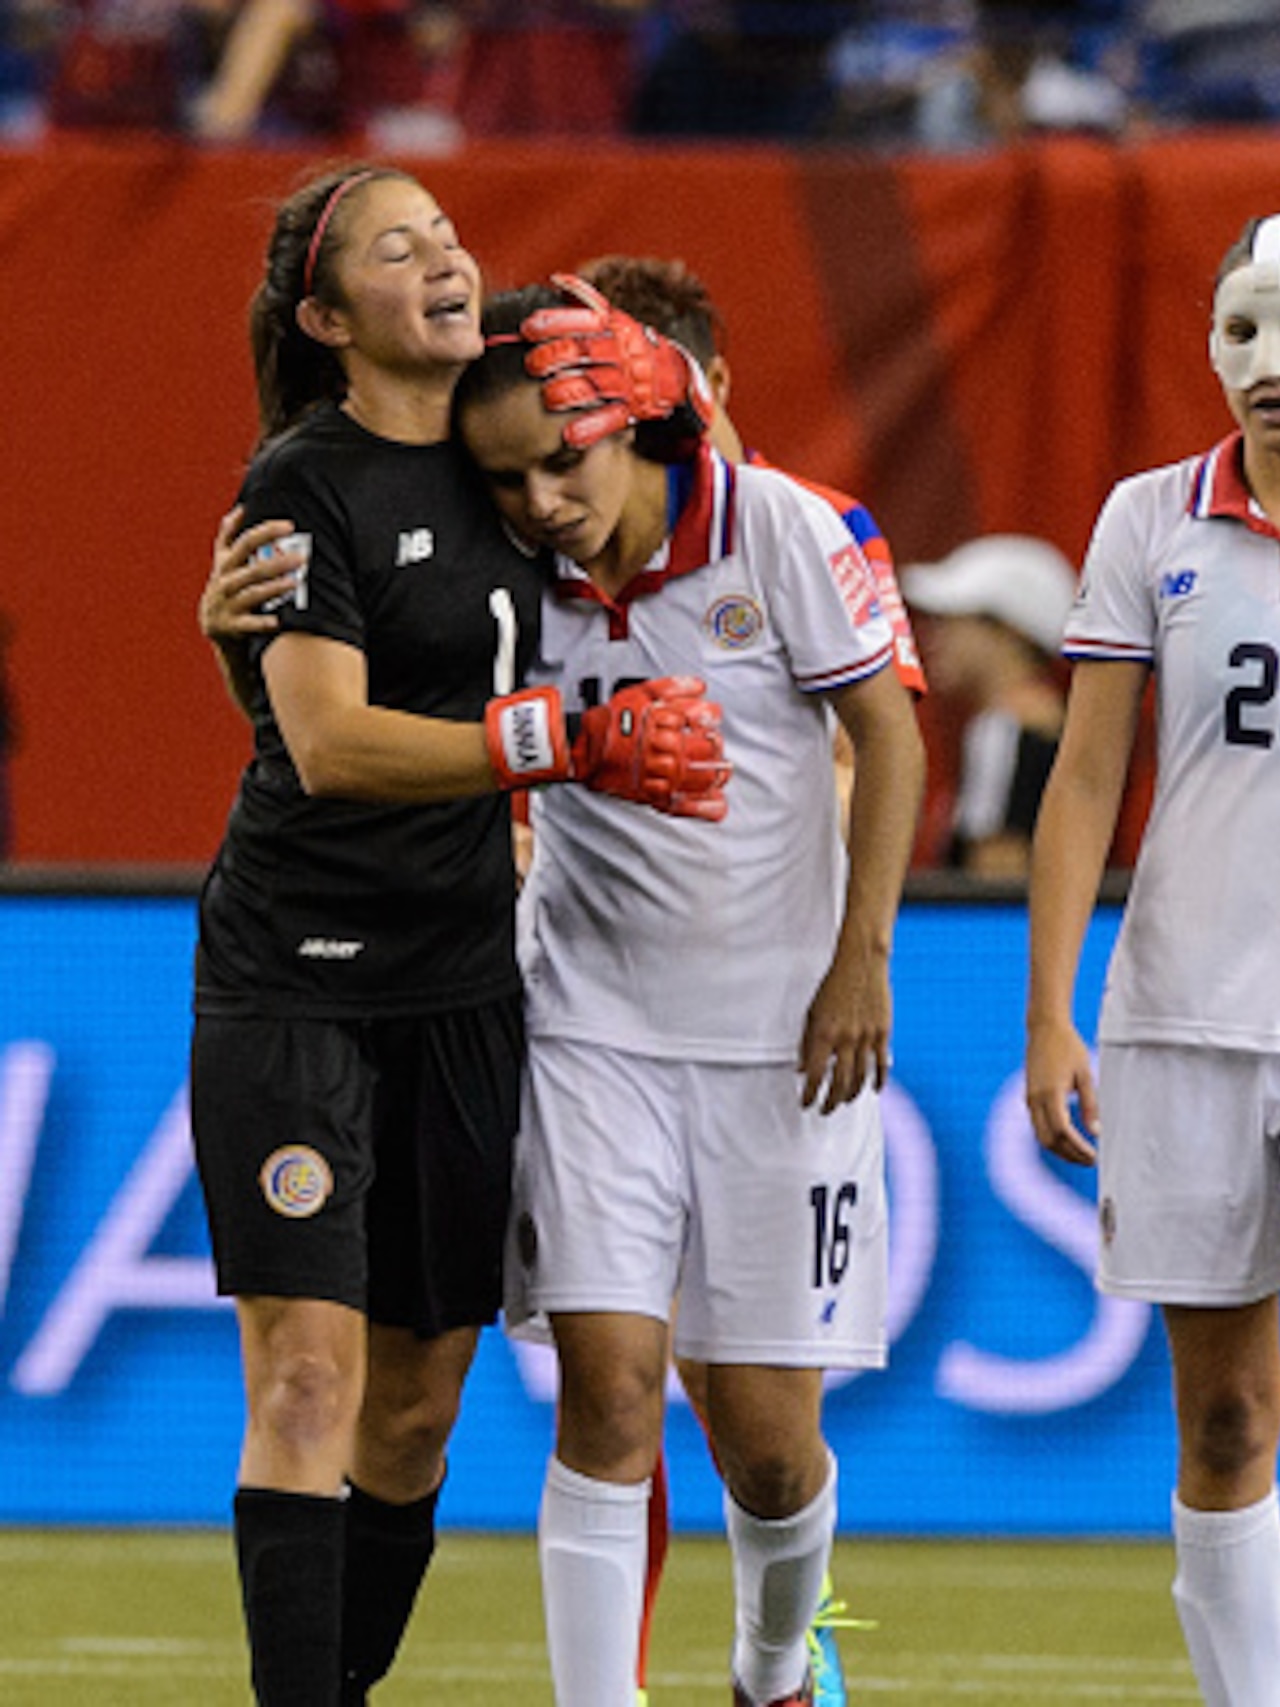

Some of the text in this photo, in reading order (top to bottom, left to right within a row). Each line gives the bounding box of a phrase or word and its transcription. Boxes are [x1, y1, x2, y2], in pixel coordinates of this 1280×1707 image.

[1158, 569, 1199, 599] NB
[488, 586, 517, 696] 1
[810, 1181, 858, 1289] 16
